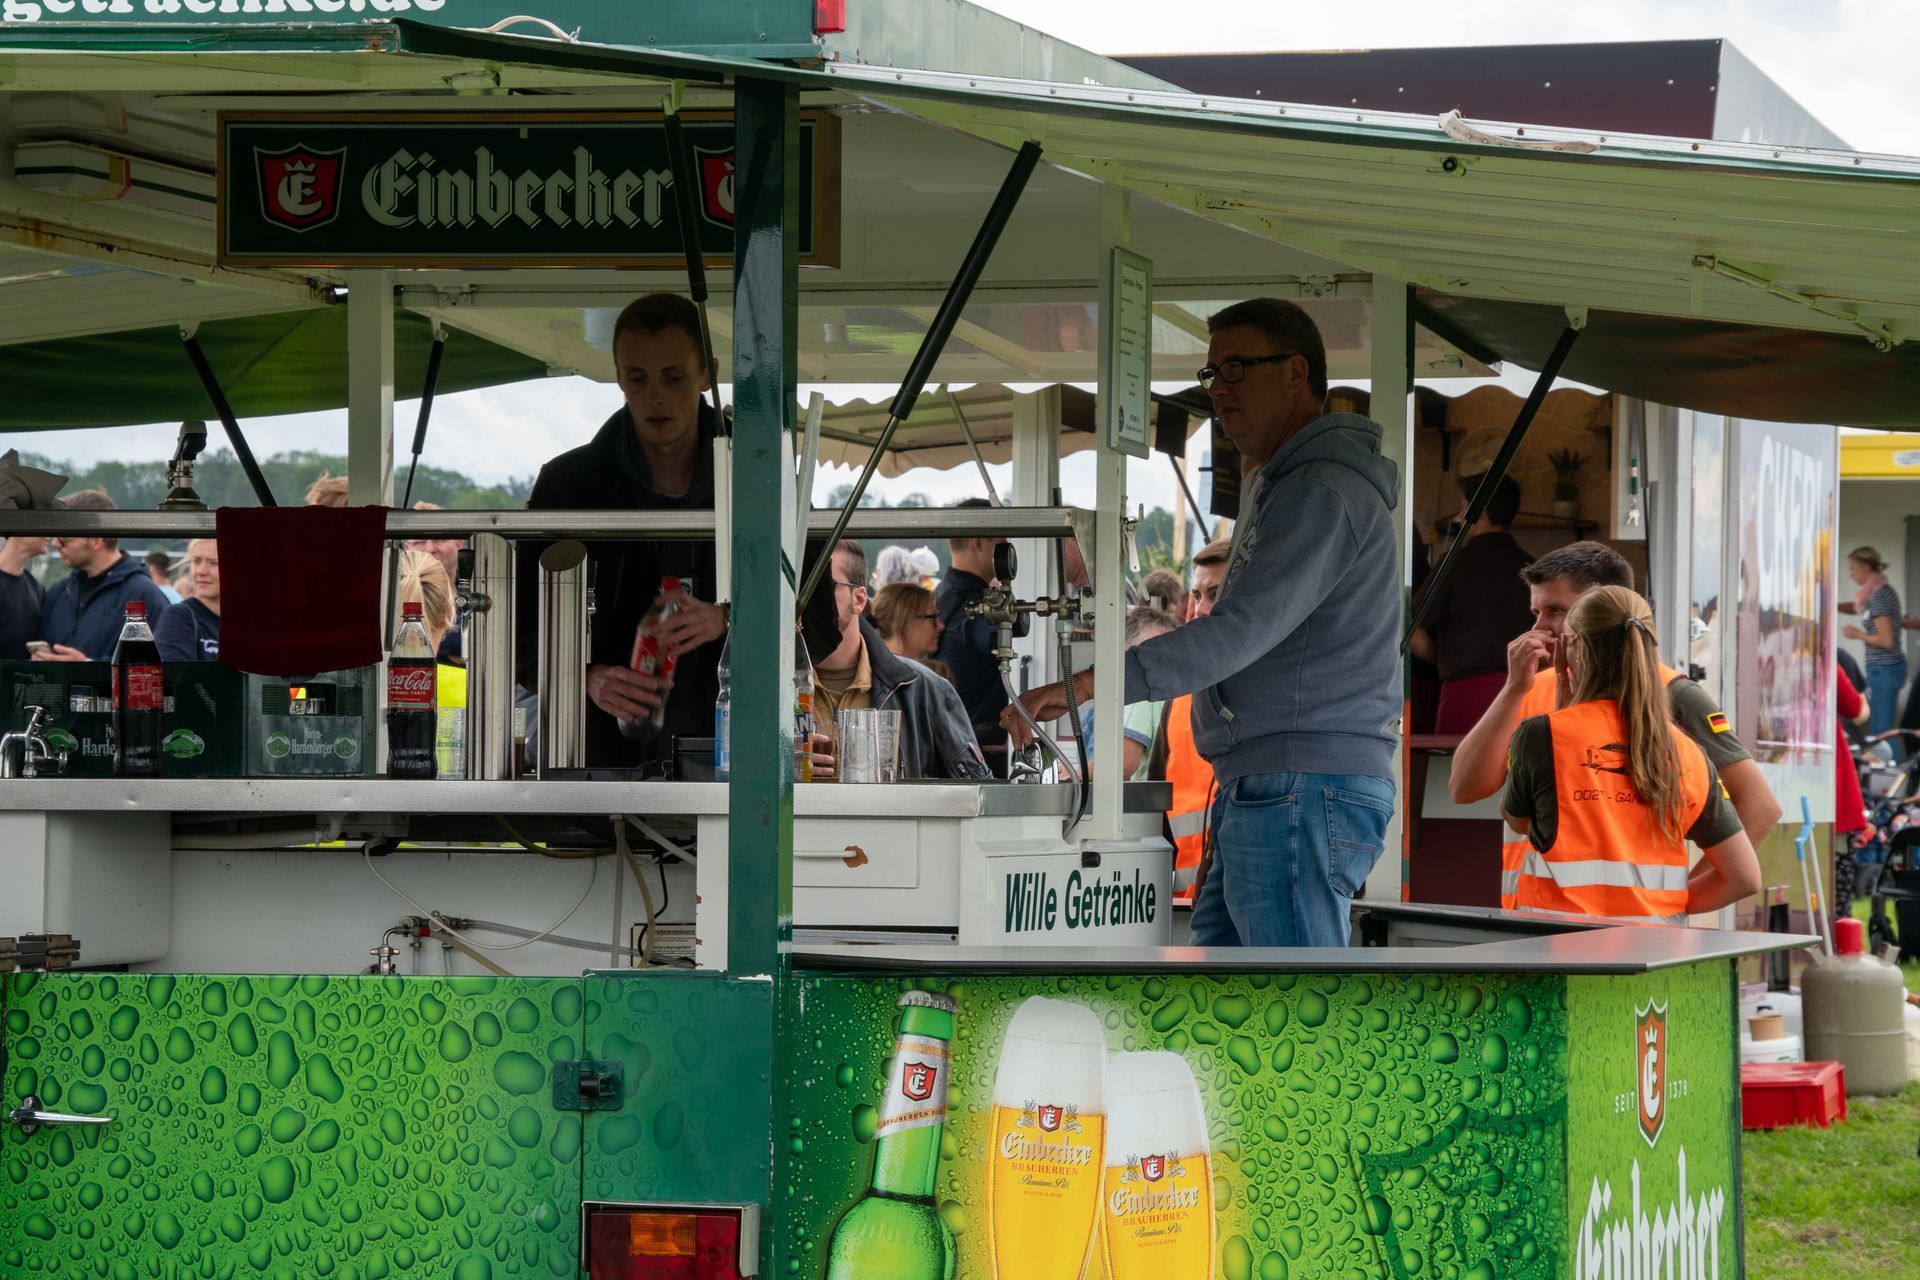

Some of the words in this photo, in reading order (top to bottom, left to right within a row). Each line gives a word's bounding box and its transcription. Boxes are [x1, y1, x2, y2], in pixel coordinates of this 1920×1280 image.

[361, 145, 674, 231] Einbecker
[291, 739, 333, 757] Hardenberger
[1005, 872, 1058, 933] Wille
[1064, 868, 1156, 929] Getränke
[1615, 1090, 1635, 1113] SEIT
[1668, 1079, 1689, 1100] 1378
[1001, 1131, 1093, 1166] Einbecker
[1012, 1162, 1078, 1176] BRAUHERREN
[1109, 1181, 1199, 1217] Einbecker
[1123, 1210, 1189, 1226] BRAUHERREN
